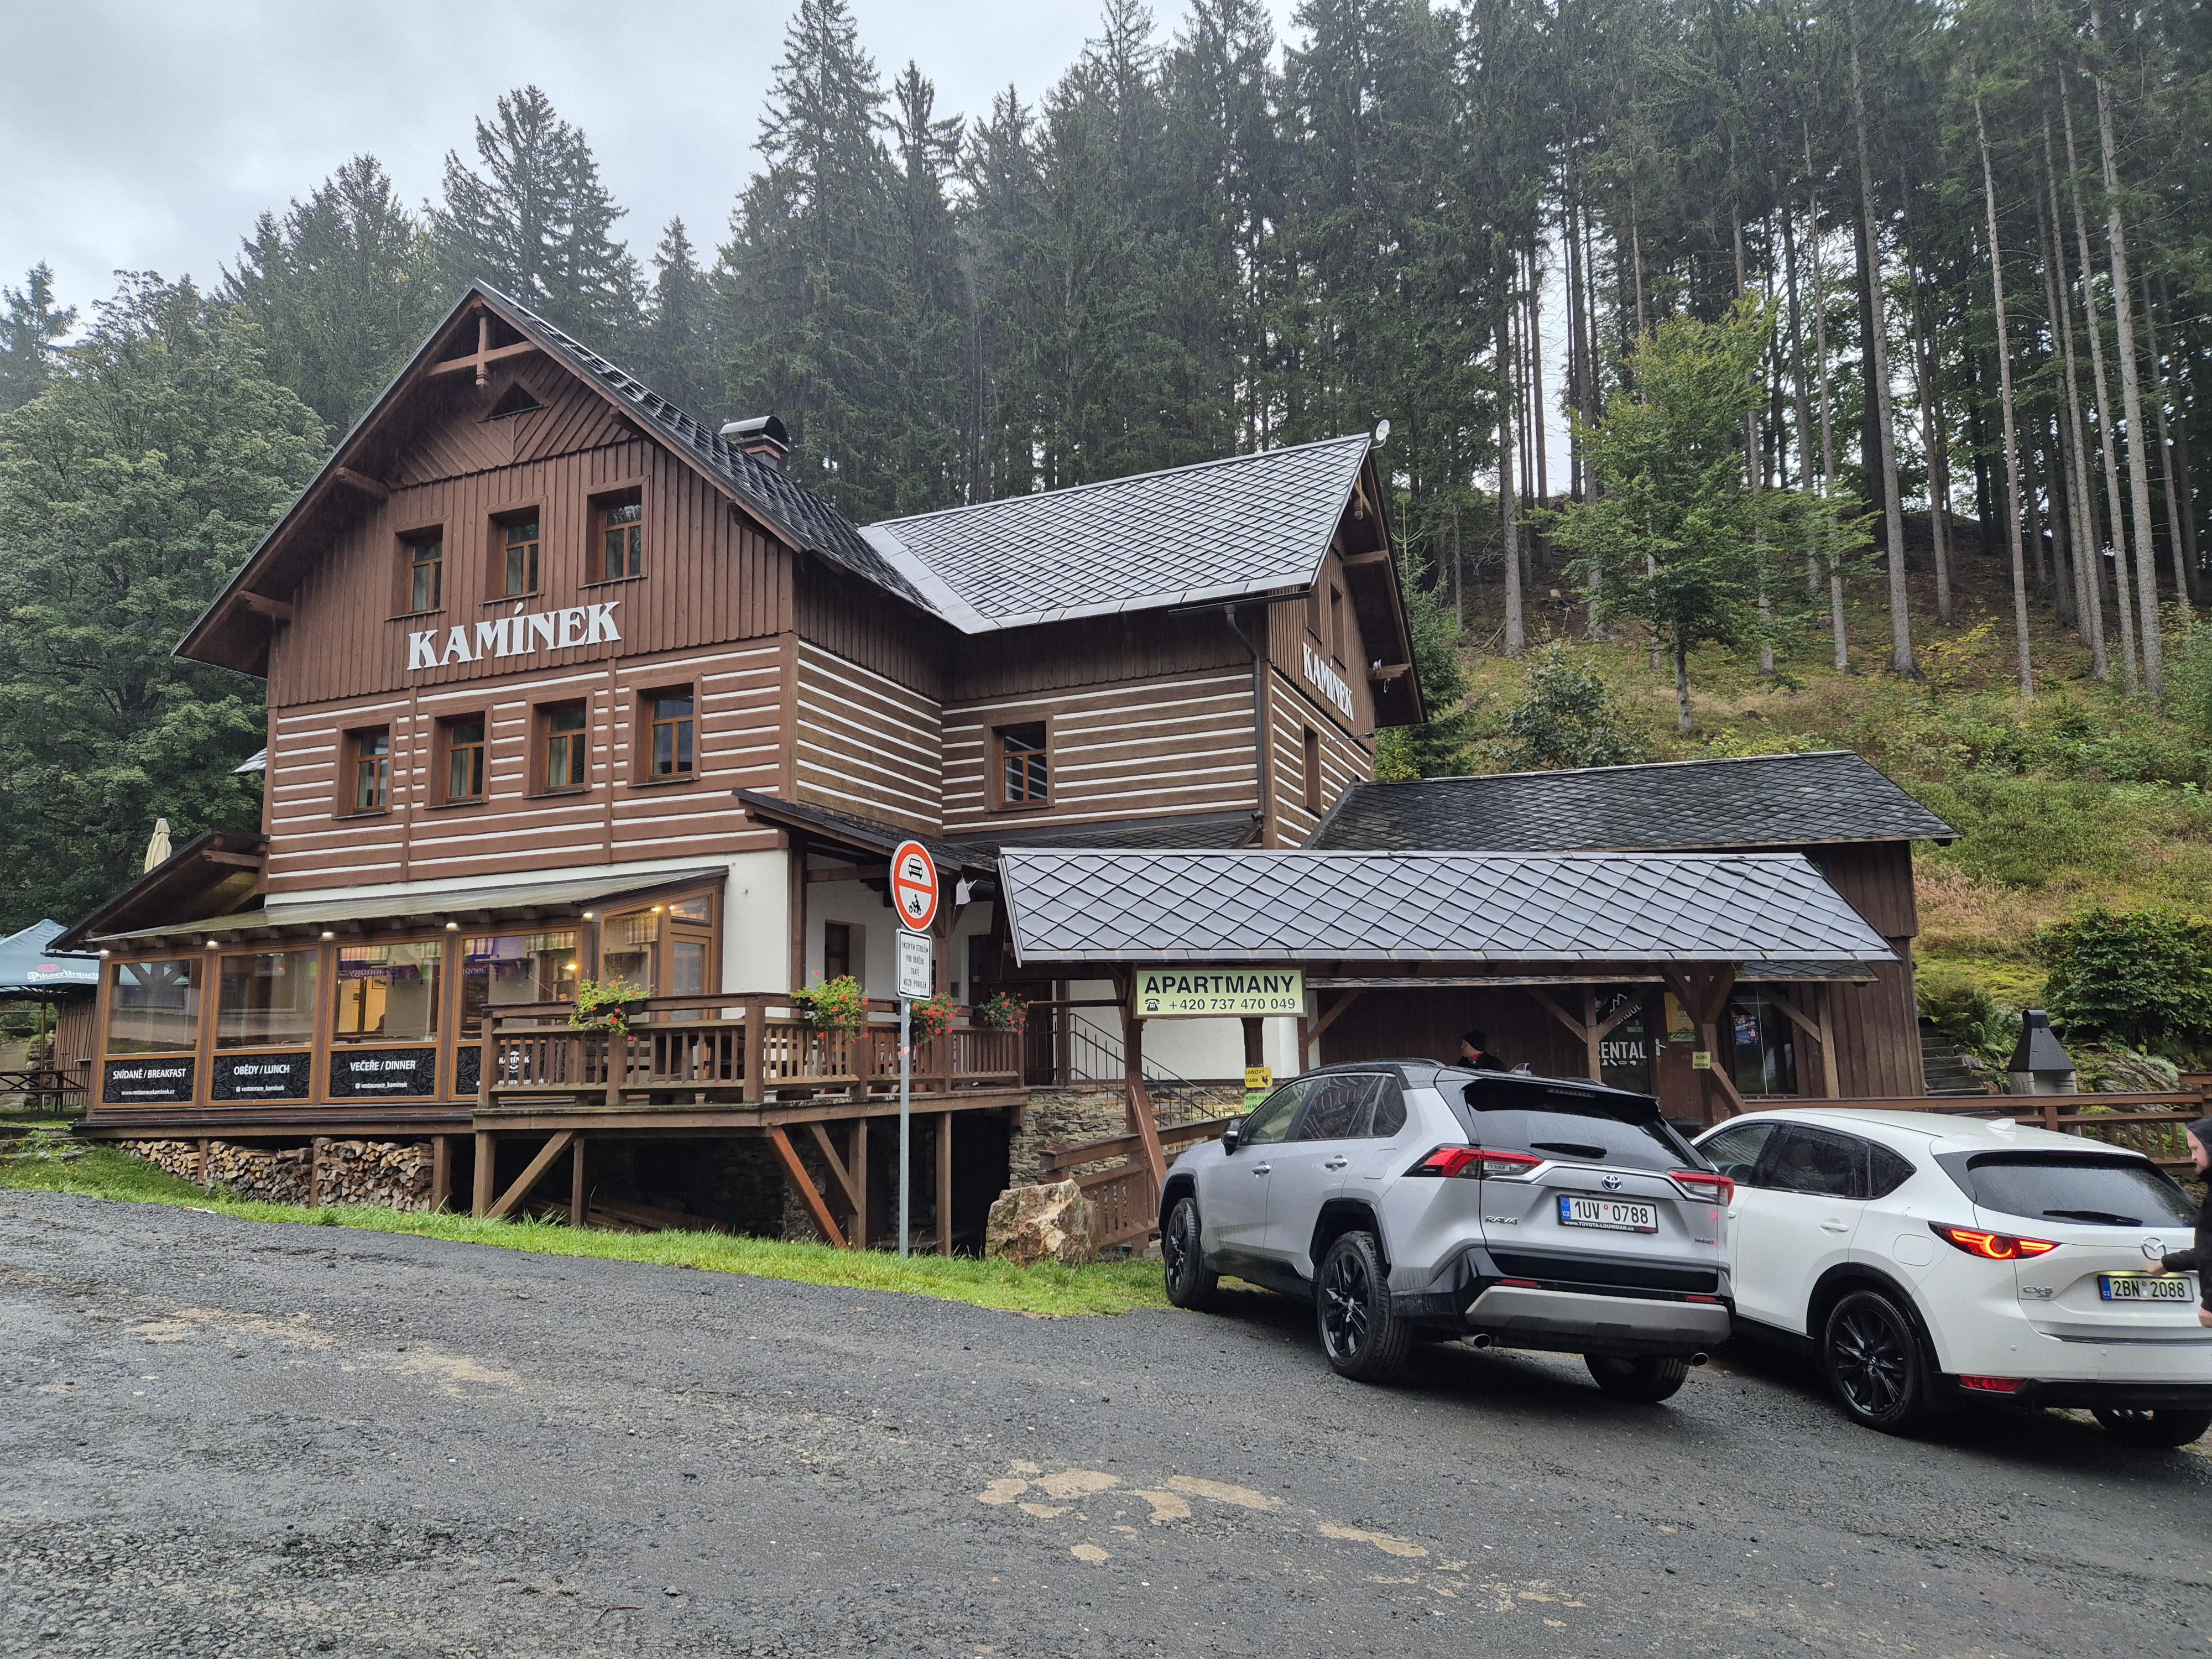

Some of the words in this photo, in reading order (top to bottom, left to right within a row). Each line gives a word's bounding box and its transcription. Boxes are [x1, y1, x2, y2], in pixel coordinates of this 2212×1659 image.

[406, 602, 622, 671] KAMÍNEK
[1302, 641, 1354, 722] KAMÍNEK
[28, 972, 65, 982] Pilsner
[1144, 975, 1295, 994] APARTMANY
[1168, 999, 1206, 1010] +420
[1210, 999, 1235, 1010] 737
[1240, 999, 1266, 1009] 470
[1270, 998, 1296, 1009] 049
[1598, 1041, 1647, 1059] ENTAL
[233, 1065, 259, 1075] OBĚDY
[264, 1065, 290, 1074] LUNCH
[350, 1060, 380, 1071] VEČEŘE
[385, 1060, 416, 1070] DINNER
[113, 1068, 143, 1079] SNÍDANĚ
[148, 1068, 186, 1078] BREAKFAST
[1575, 1201, 1599, 1220] 1UV
[1613, 1205, 1648, 1224] 0788
[1485, 1215, 1518, 1224] RAV4
[1564, 1220, 1634, 1231] www.TOYOTA-LOUWMAN.cz
[2022, 1286, 2053, 1294] CX-5
[2114, 1280, 2141, 1297] 2BN
[2151, 1281, 2184, 1297] 2088
